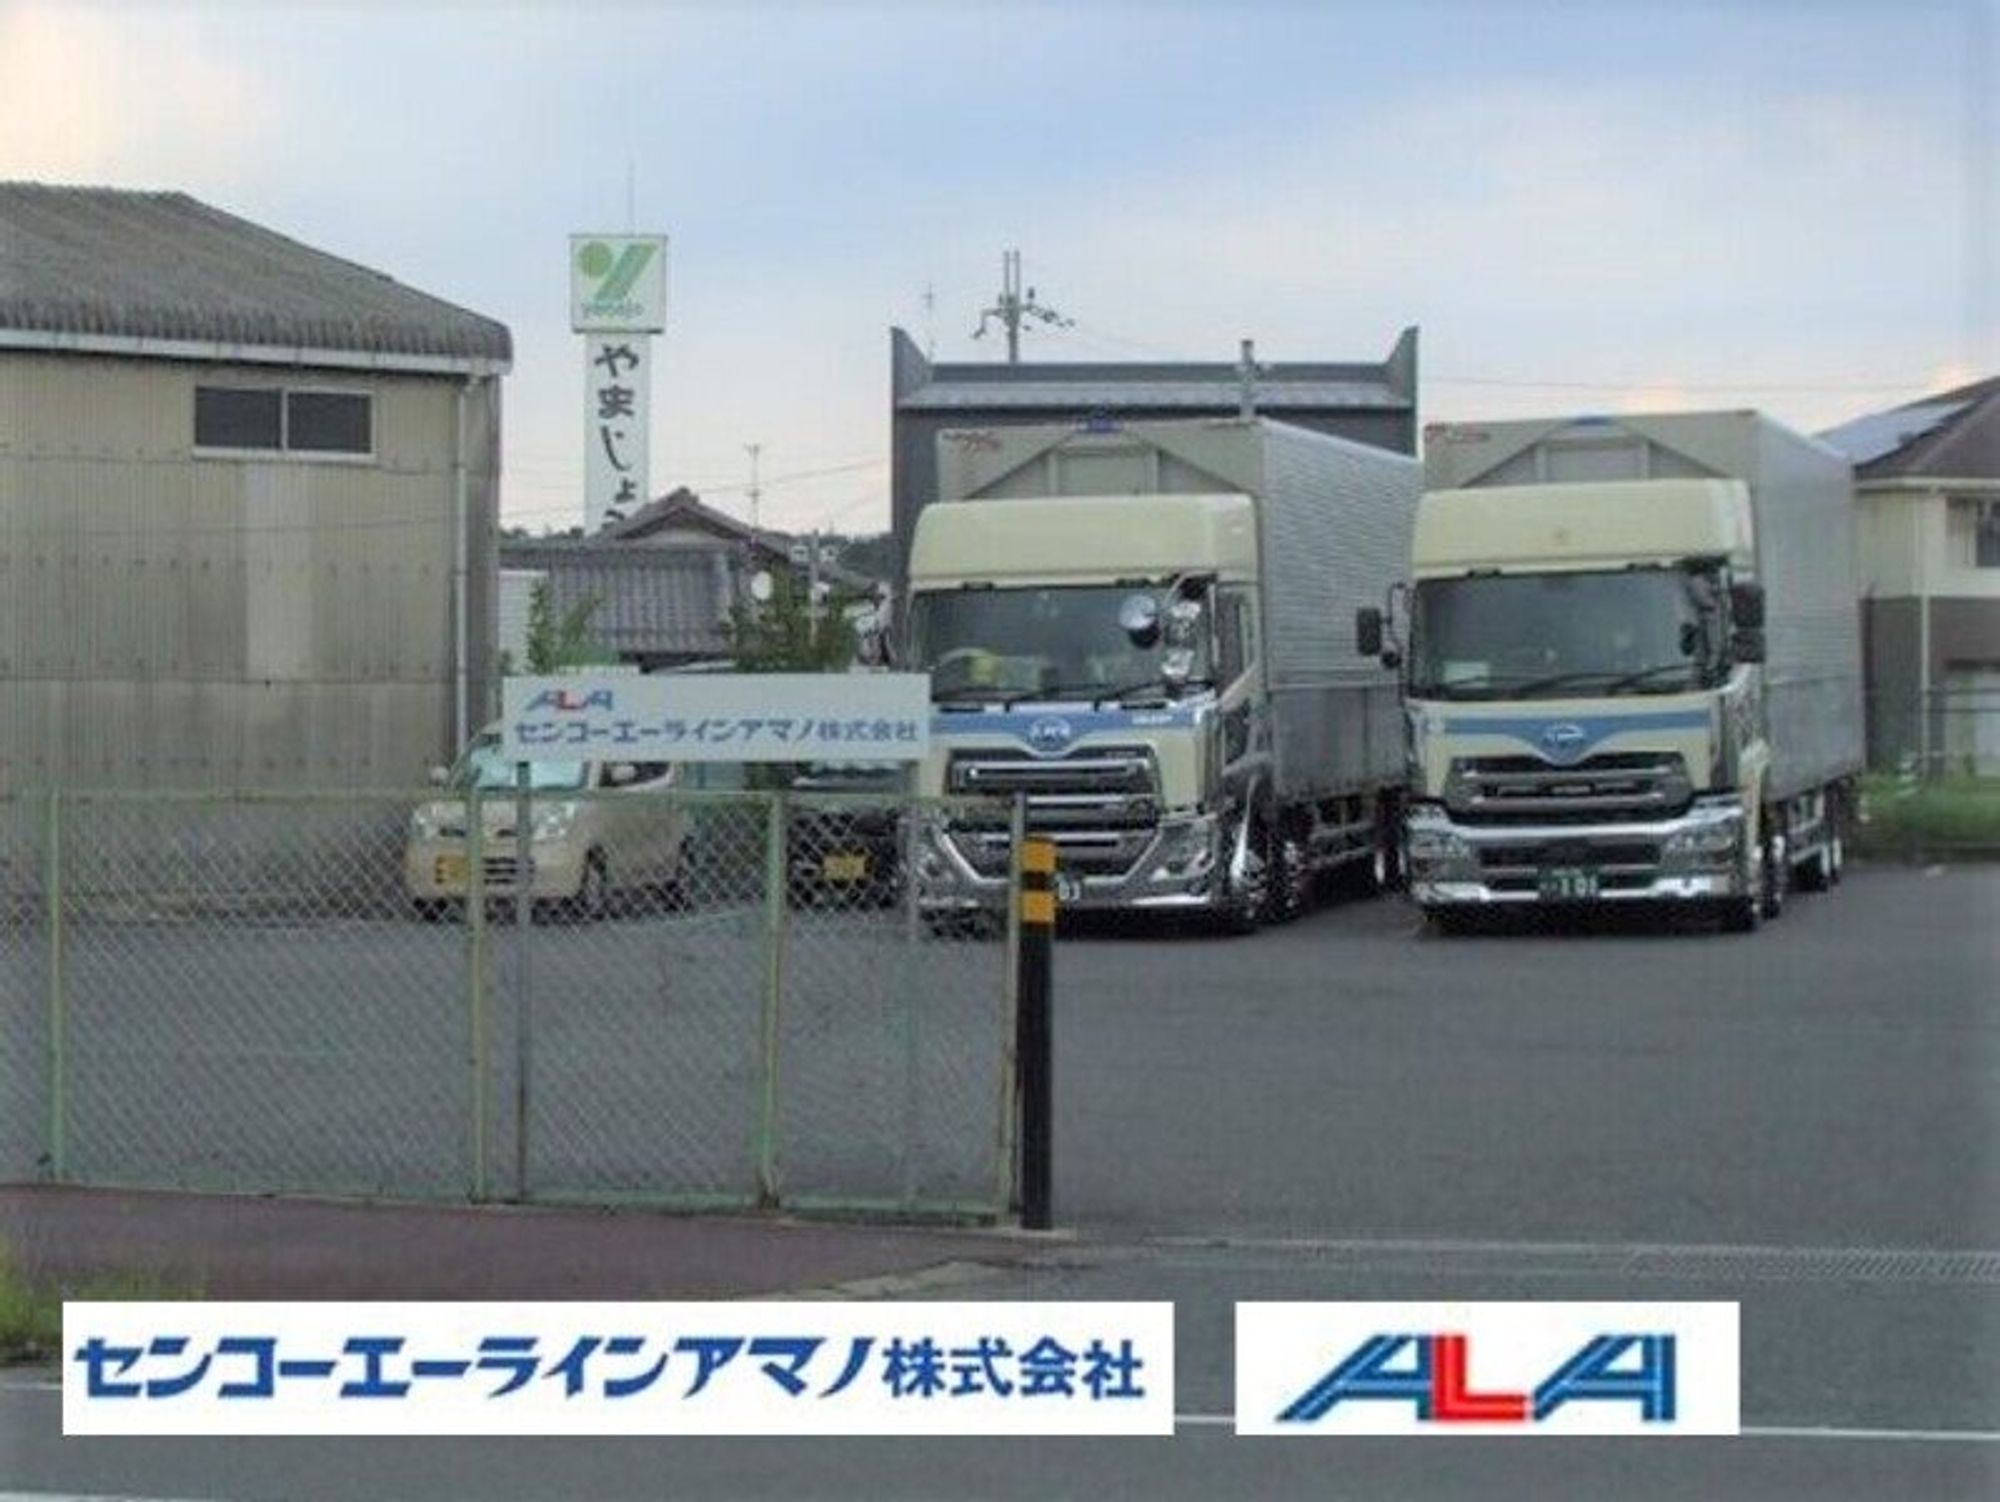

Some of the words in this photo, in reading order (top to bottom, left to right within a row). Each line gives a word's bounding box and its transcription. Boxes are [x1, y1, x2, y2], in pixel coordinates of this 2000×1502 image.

[525, 690, 614, 712] ALA
[515, 718, 918, 743] センコーエーラインアマノ株式会社
